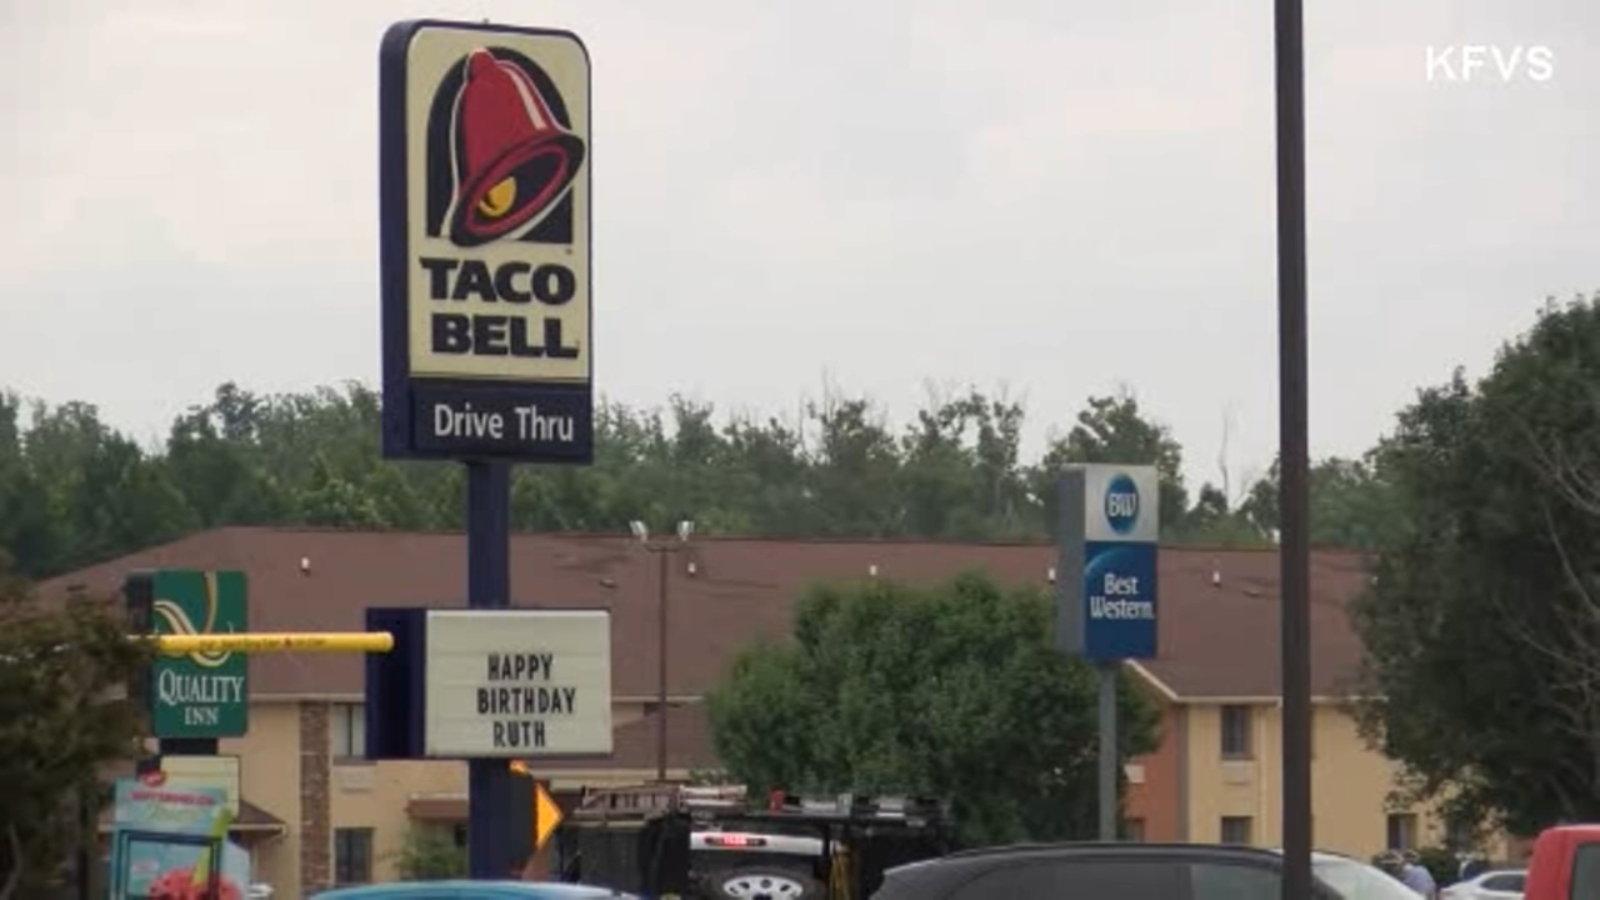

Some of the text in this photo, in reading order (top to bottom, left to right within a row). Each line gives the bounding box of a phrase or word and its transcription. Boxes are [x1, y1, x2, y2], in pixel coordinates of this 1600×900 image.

[420, 256, 577, 305] TACO
[431, 312, 579, 359] BELL
[433, 401, 574, 442] Drive Thru
[1107, 493, 1137, 517] BW
[1104, 573, 1138, 595] Best
[487, 653, 554, 681] HAPPY
[477, 688, 576, 715] BIRTHDAY
[184, 707, 219, 726] INN
[493, 720, 546, 748] RUTH
